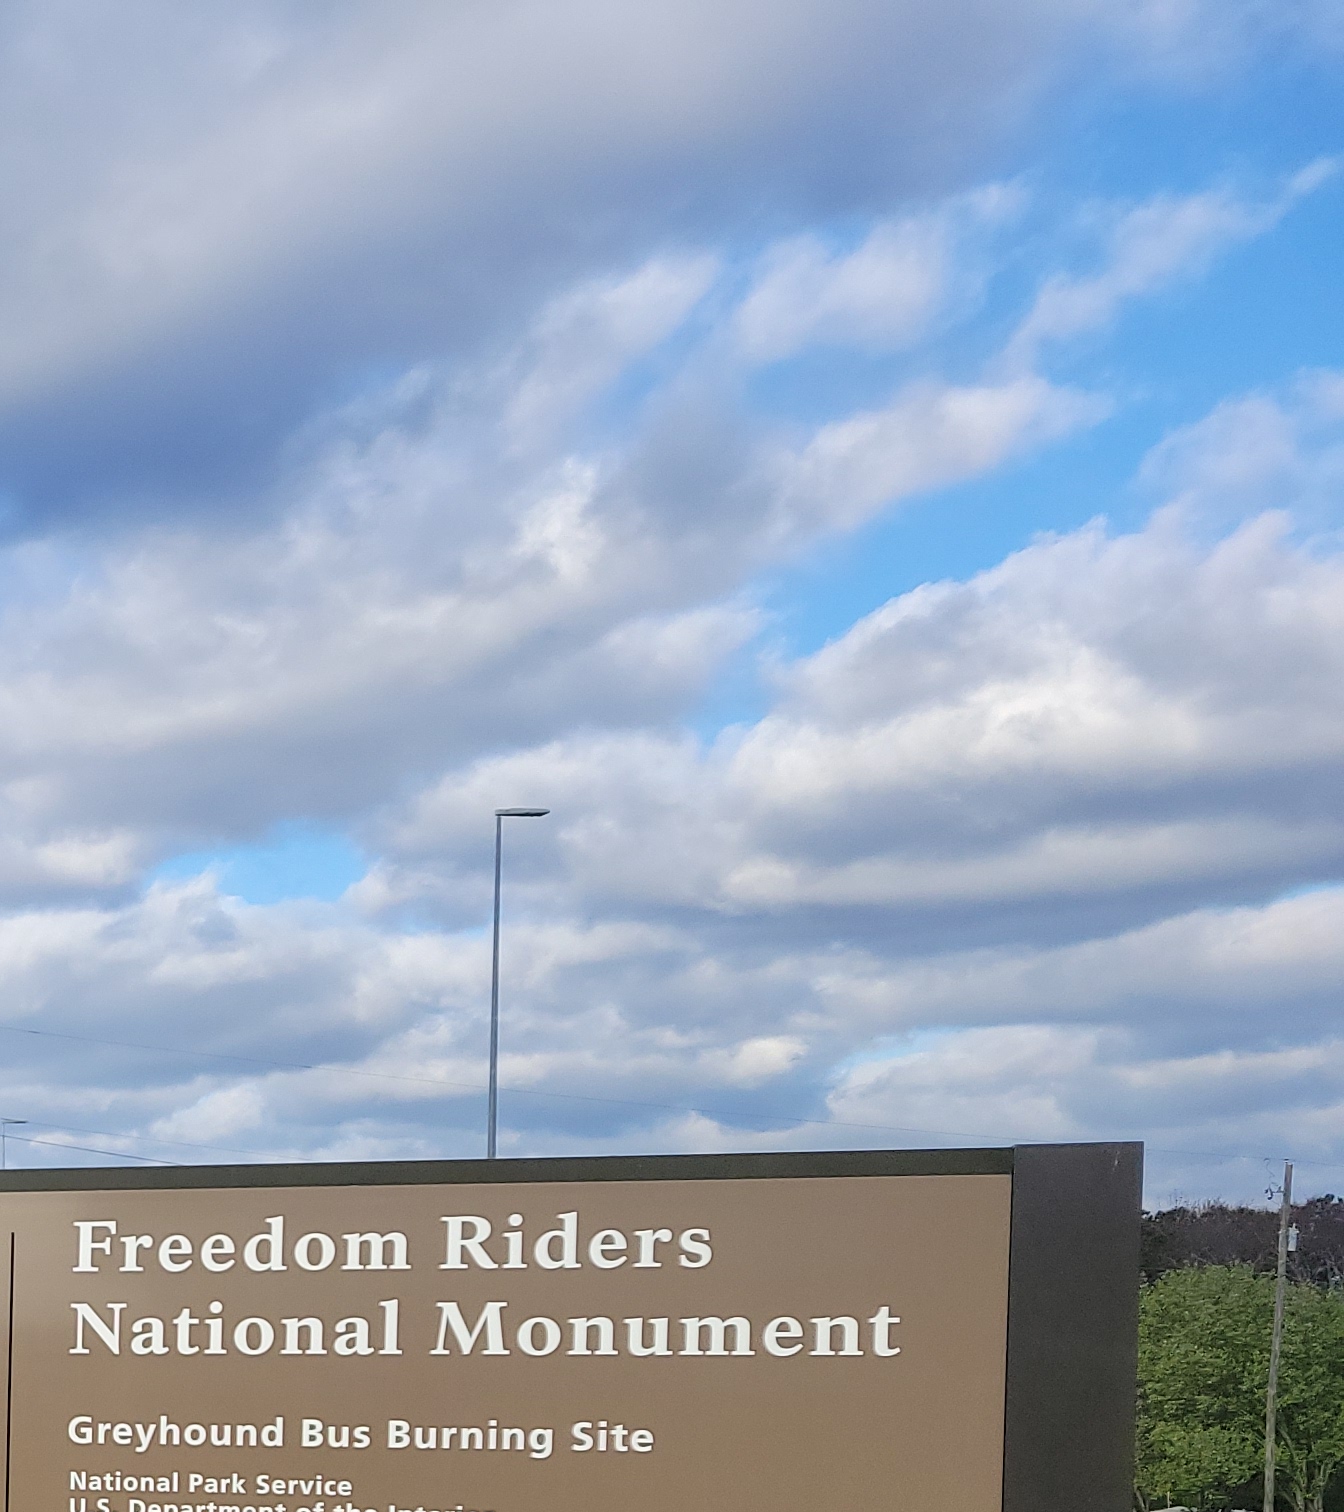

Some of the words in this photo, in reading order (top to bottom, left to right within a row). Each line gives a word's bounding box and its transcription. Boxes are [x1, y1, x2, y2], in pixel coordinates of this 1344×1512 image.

[72, 1215, 412, 1273] Freedom
[438, 1211, 713, 1270] Riders
[68, 1299, 403, 1356] National
[428, 1301, 901, 1357] Monument
[67, 1415, 284, 1453] Greyhound
[300, 1418, 371, 1449] Bus
[387, 1419, 554, 1459] Burning
[570, 1420, 654, 1453] Site
[69, 1471, 179, 1493] National
[188, 1472, 247, 1494] Park
[255, 1474, 353, 1497] Service
